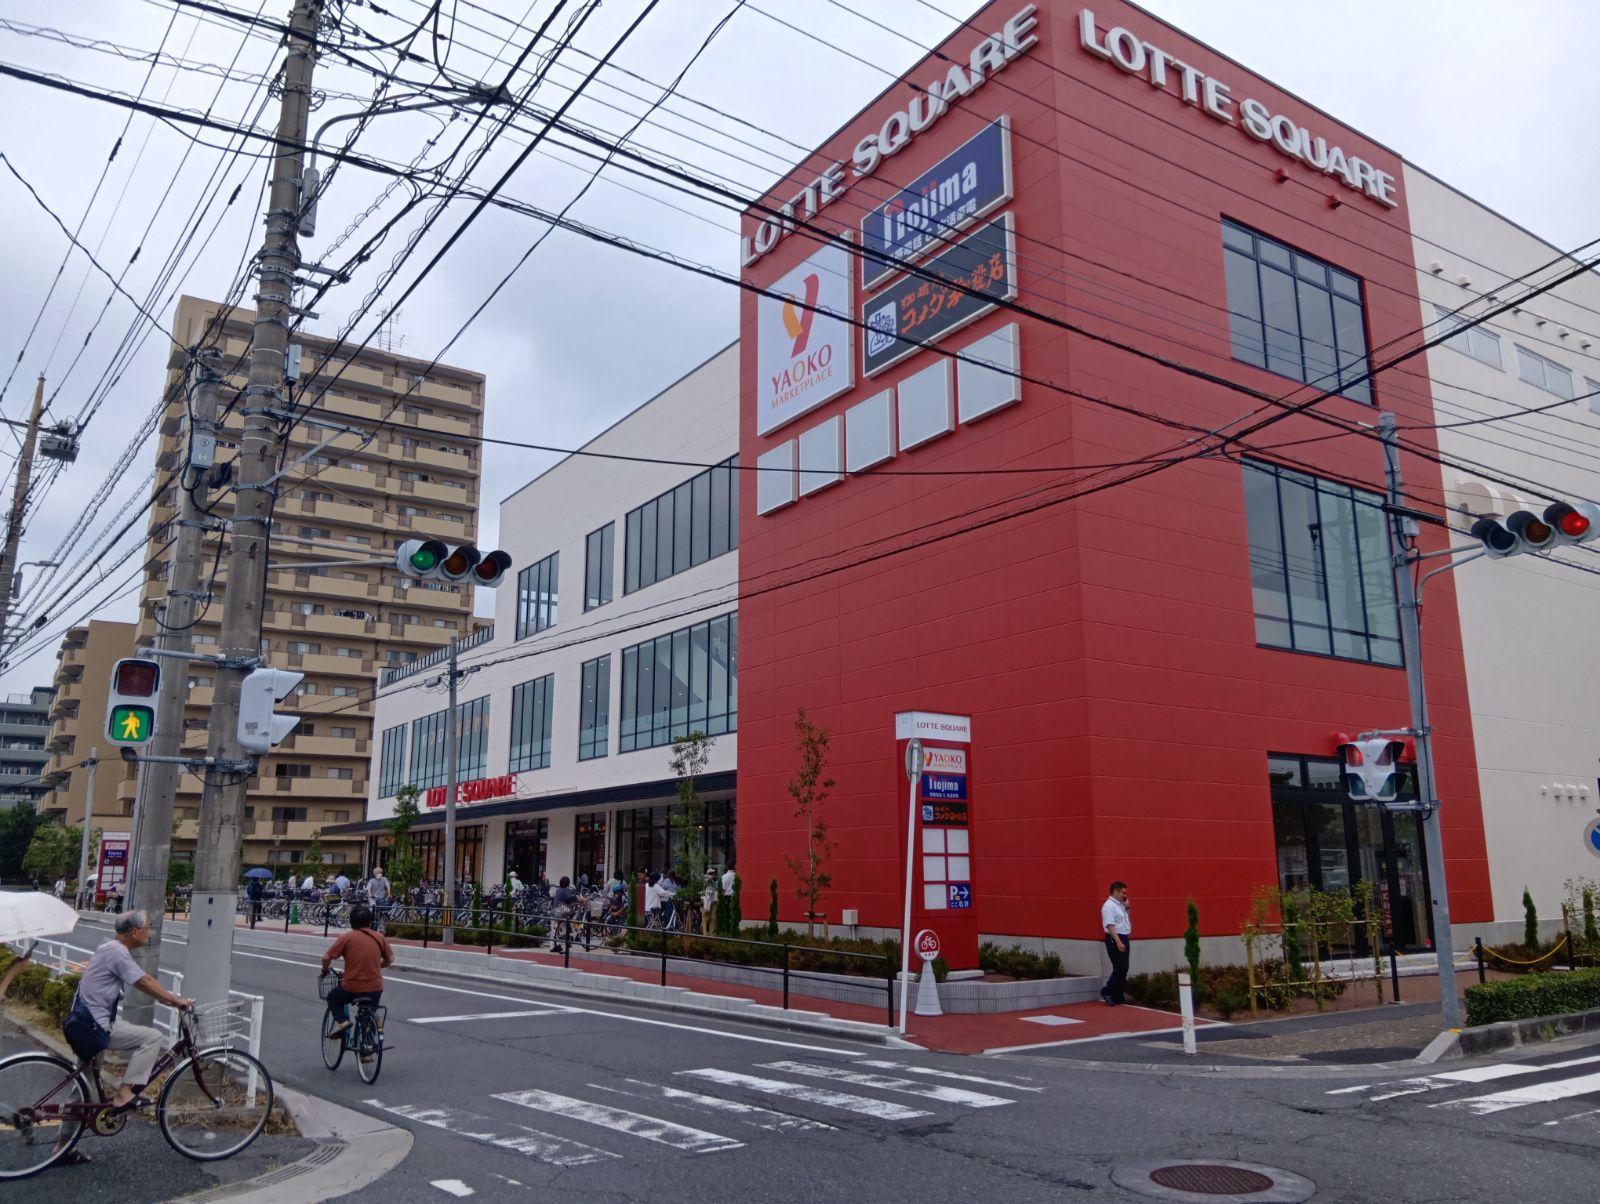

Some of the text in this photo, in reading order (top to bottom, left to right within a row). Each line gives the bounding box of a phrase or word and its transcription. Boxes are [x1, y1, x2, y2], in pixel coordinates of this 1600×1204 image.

[1079, 8, 1398, 209] LOTTE SQUARE
[741, 3, 1039, 269] LOTTE SQUARE
[771, 344, 832, 395] YAOKO
[771, 367, 833, 410] MARKETPLACE
[916, 721, 968, 733] LOTTE SQUARE
[934, 752, 962, 764] YAOKO
[426, 773, 517, 807] LOTE SQUARE
[950, 885, 959, 901] P
